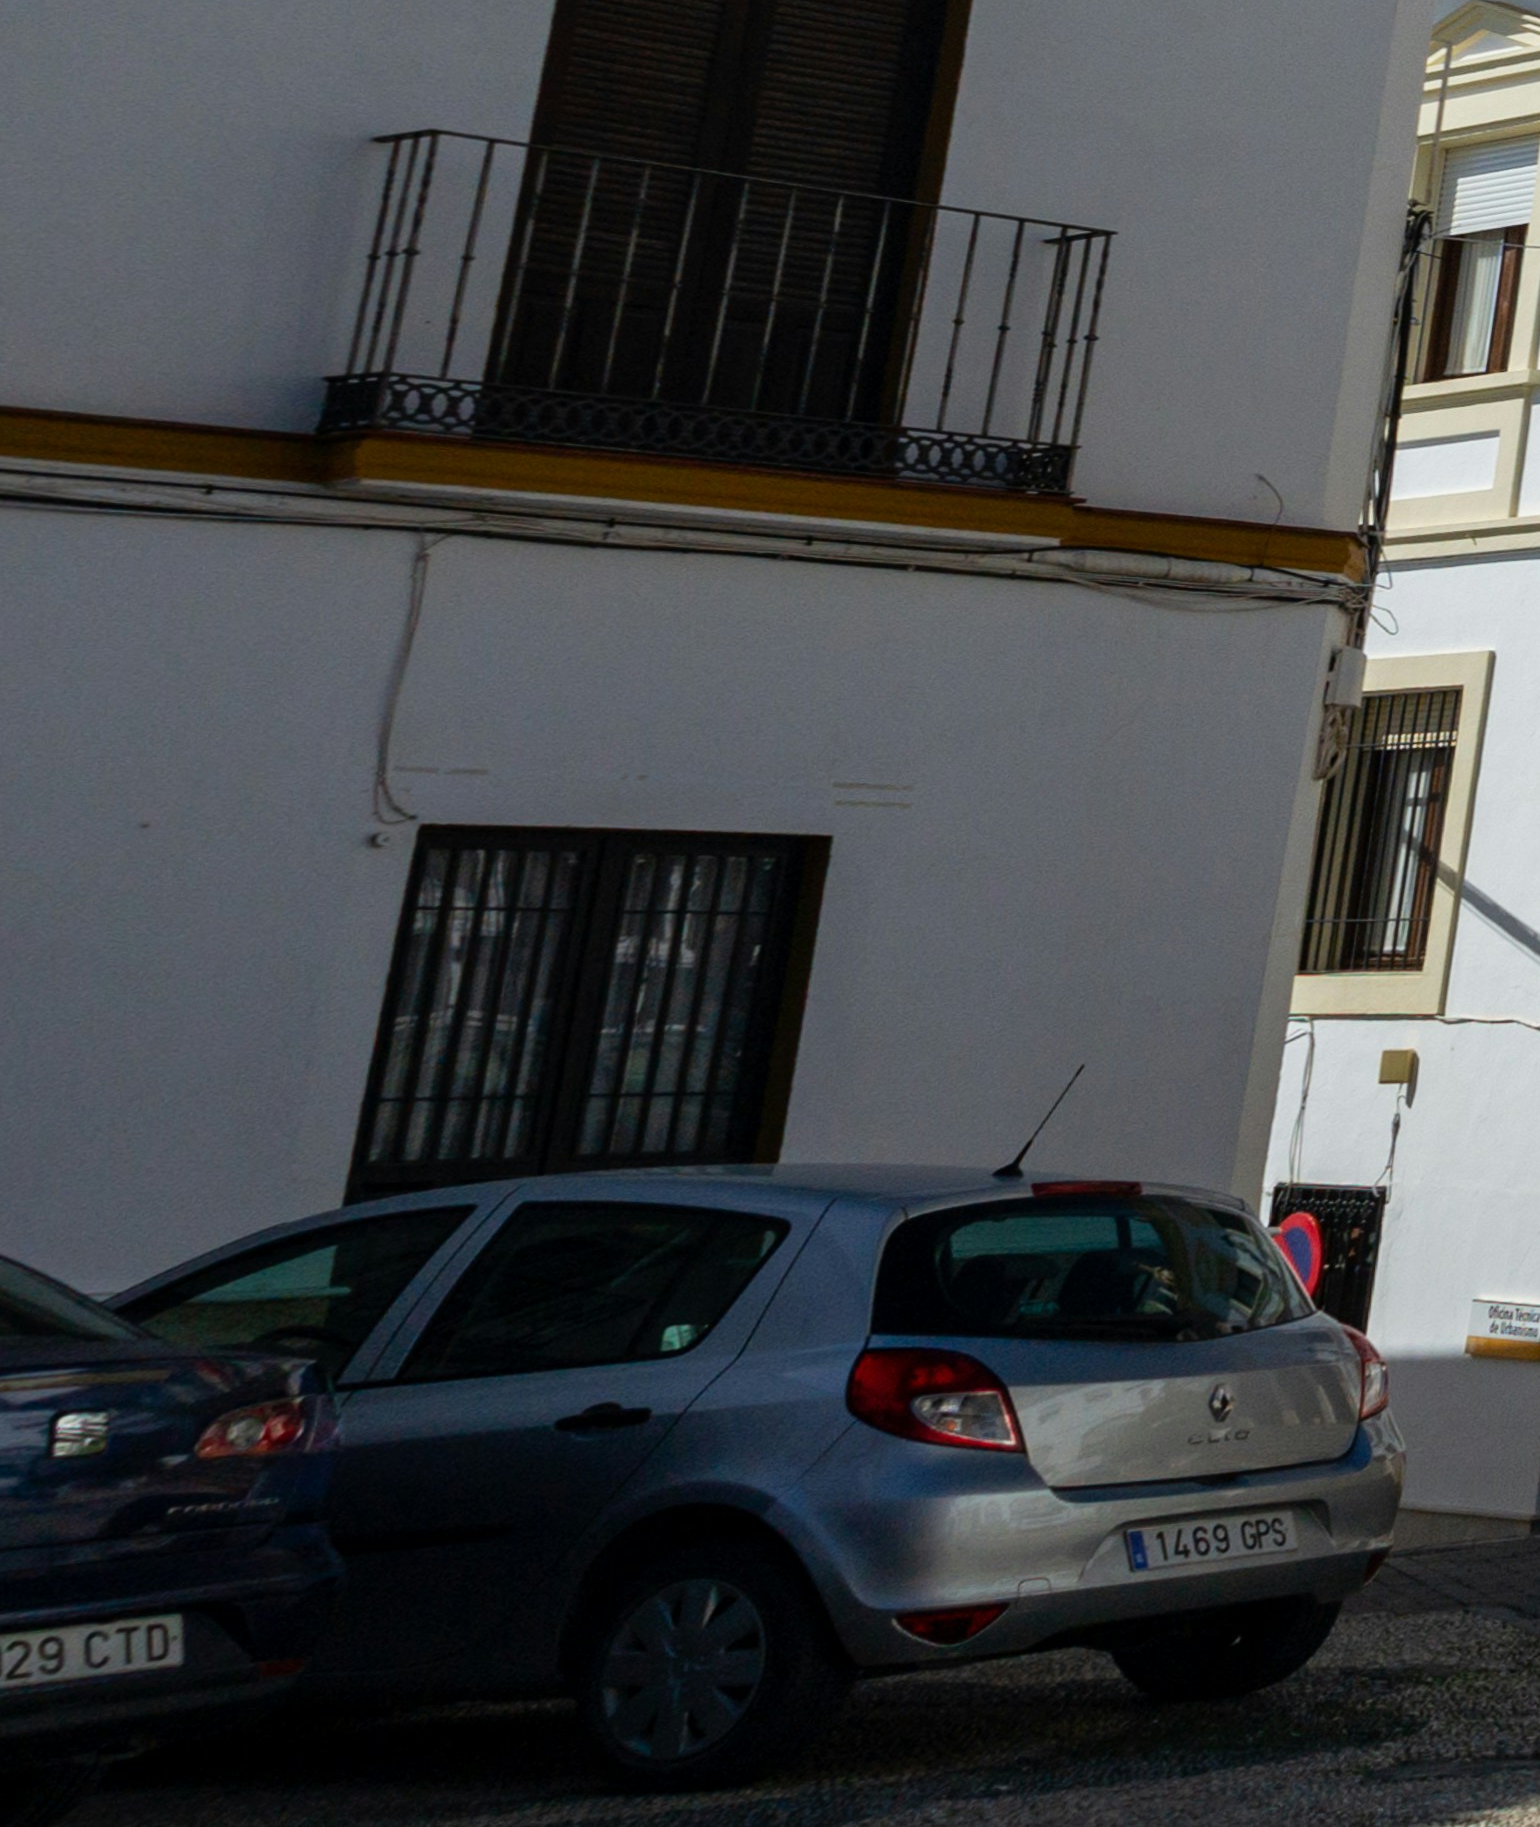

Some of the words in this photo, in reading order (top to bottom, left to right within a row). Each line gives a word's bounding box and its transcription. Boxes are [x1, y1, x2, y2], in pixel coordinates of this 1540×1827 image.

[1488, 1305, 1513, 1320] Oficina
[1516, 1307, 1540, 1323] Técnica
[1490, 1320, 1499, 1333] de
[1500, 1321, 1538, 1338] Urbanismo
[1187, 1430, 1250, 1445] CLIO
[1156, 1523, 1230, 1561] 1469
[1240, 1517, 1287, 1550] GPS
[0, 1636, 65, 1681] 29
[84, 1623, 169, 1669] CTD
